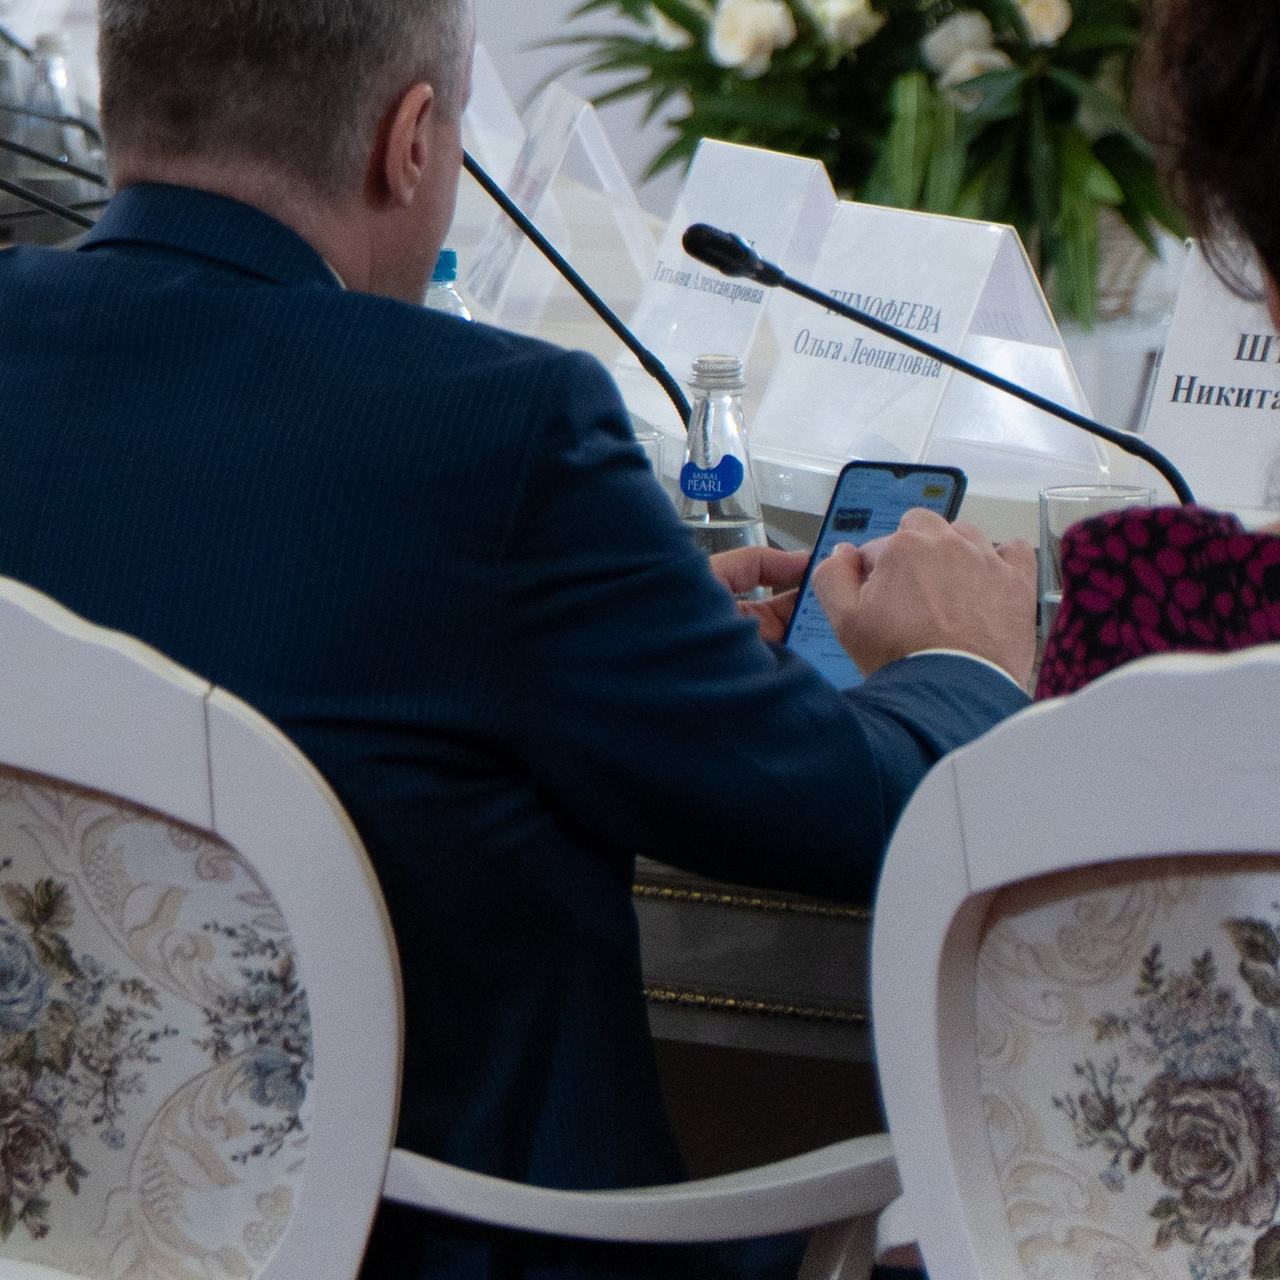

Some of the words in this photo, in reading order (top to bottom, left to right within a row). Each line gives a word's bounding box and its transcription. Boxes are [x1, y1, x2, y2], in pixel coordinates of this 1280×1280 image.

[794, 328, 843, 361] Ольга
[843, 337, 943, 379] Леонидовна
[687, 479, 723, 492] PEARL
